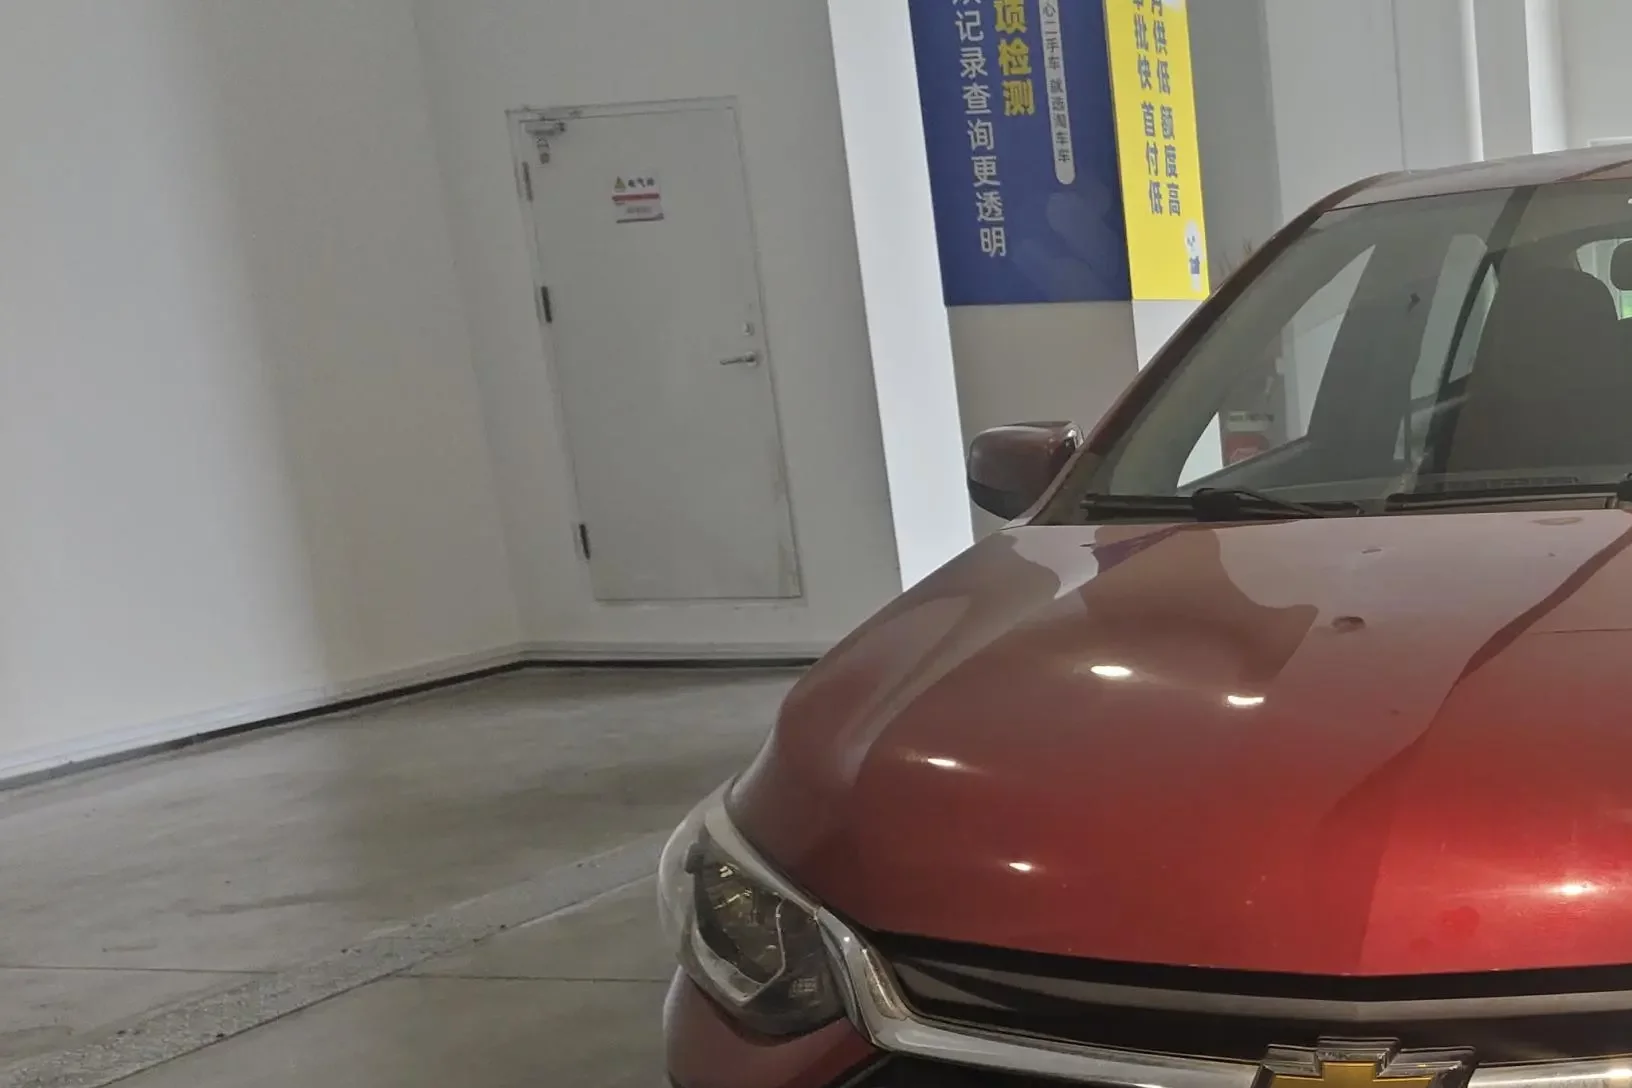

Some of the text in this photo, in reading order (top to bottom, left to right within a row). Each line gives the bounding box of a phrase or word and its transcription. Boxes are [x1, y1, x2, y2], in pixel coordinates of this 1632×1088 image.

[993, 0, 1035, 117] 项检测
[952, 0, 1007, 257] 记录查询更透明
[1141, 101, 1163, 215] 首付低
[1160, 104, 1181, 216] 额度高
